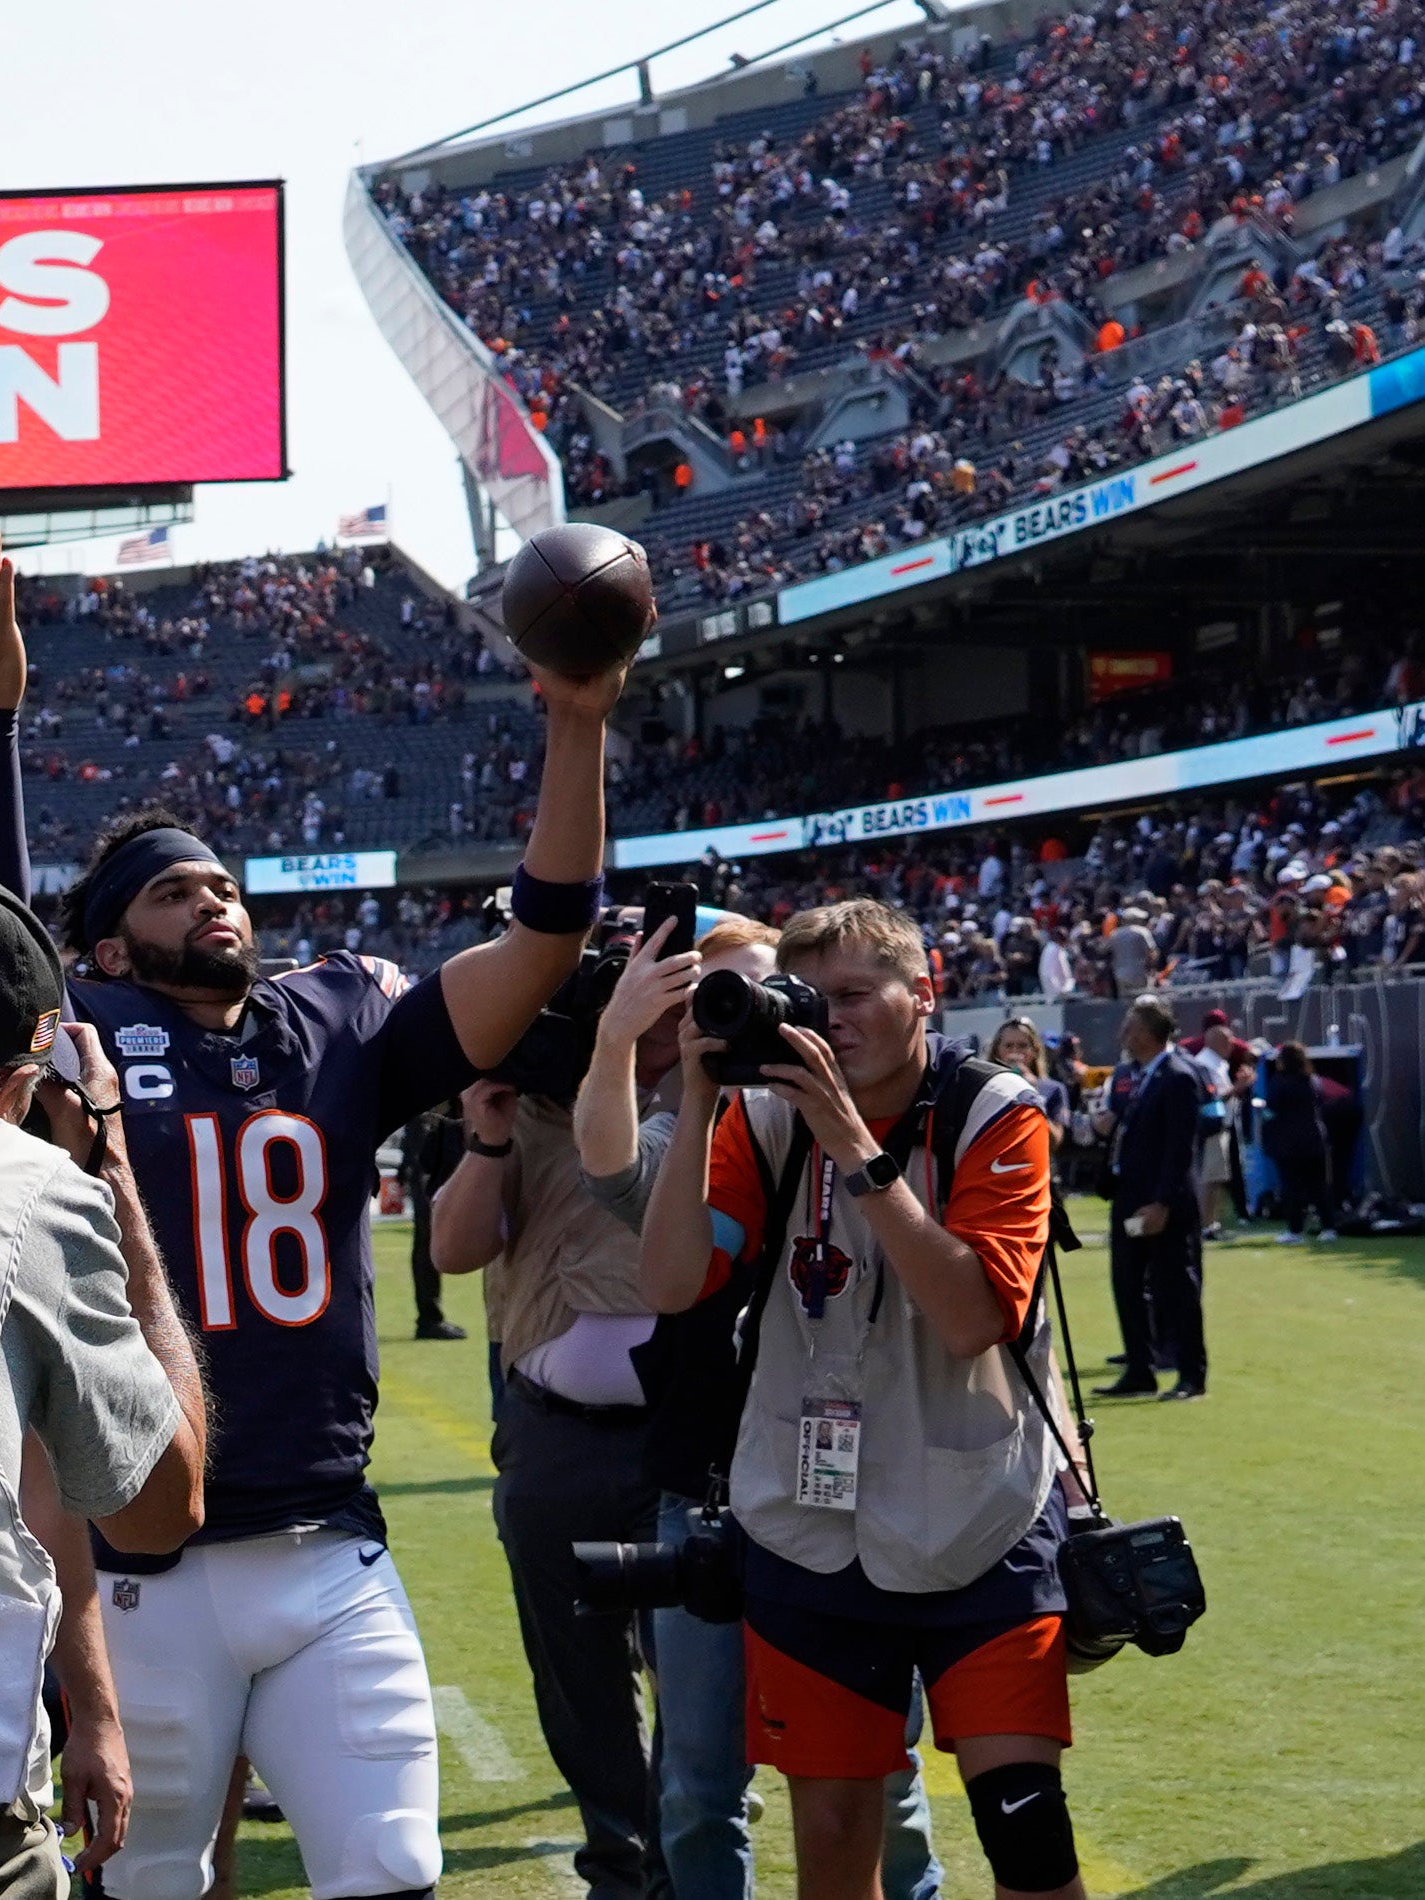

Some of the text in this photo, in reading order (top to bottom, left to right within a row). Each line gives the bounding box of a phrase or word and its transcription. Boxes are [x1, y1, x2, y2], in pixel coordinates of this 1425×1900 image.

[1015, 474, 1137, 544] BEARS WIN
[862, 795, 972, 833] BEARS WIN
[280, 855, 357, 874] BEARS
[312, 872, 357, 886] WIN
[124, 1064, 174, 1100] C
[236, 1071, 258, 1084] NFL
[183, 1108, 332, 1332] 18
[799, 1420, 812, 1501] OFFICIAL
